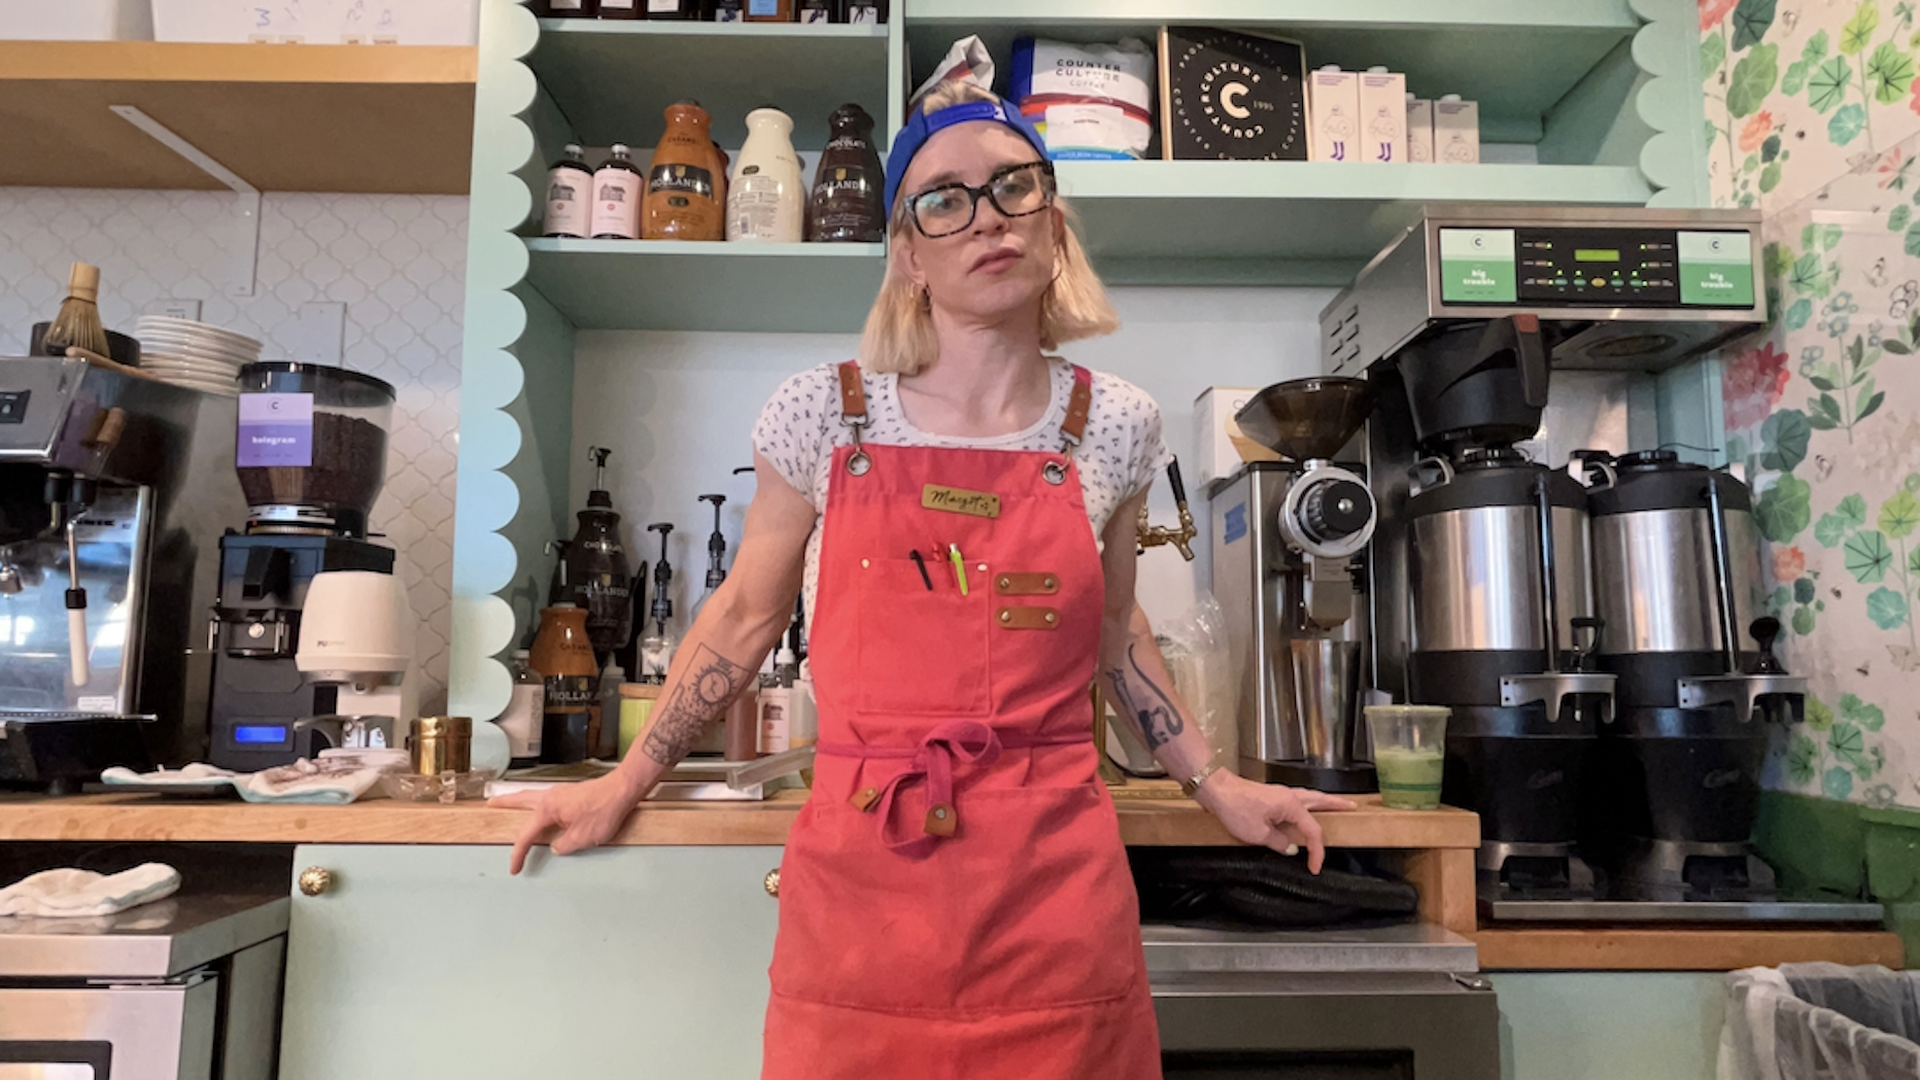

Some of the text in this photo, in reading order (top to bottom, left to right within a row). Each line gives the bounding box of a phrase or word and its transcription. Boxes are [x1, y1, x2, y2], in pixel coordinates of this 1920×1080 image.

[1056, 58, 1121, 72] COUNTER
[1055, 68, 1120, 82] CULTURE
[1253, 100, 1275, 111] 1995
[1471, 269, 1486, 280] big
[1709, 272, 1724, 282] big
[1462, 278, 1496, 286] trouble
[1700, 280, 1734, 289] trouble
[251, 436, 297, 446] hologram
